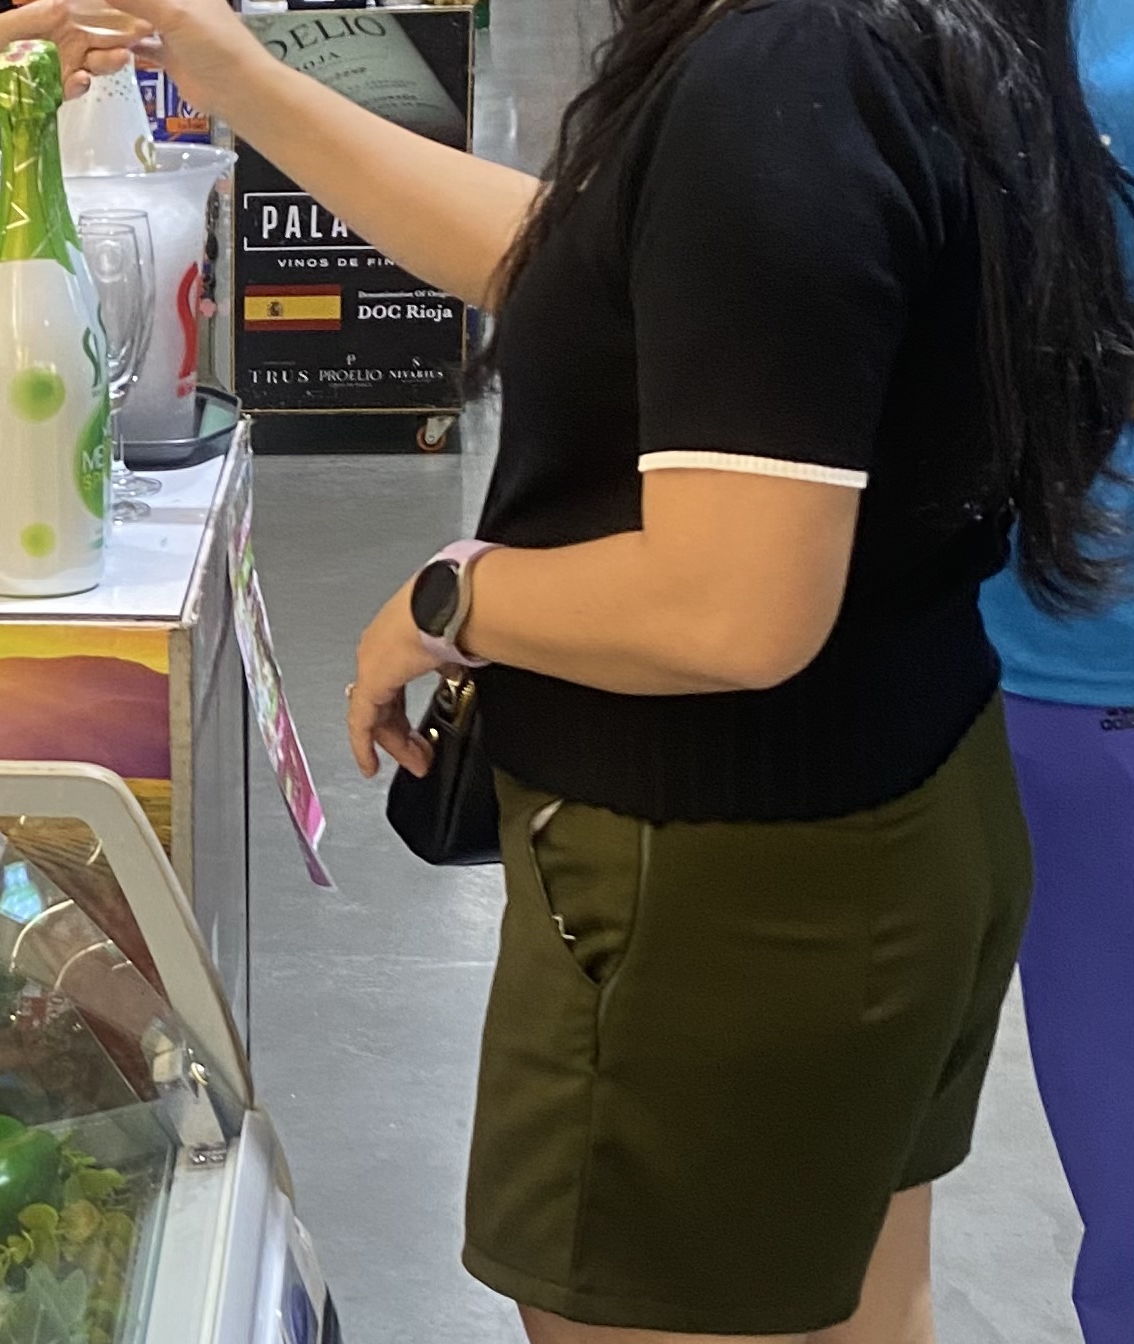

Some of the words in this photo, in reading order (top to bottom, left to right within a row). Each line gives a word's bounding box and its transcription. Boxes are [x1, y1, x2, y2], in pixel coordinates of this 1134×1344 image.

[261, 204, 349, 240] PALA
[277, 258, 329, 268] VINOS
[337, 258, 359, 268] DE
[367, 256, 395, 267] FIN
[357, 306, 401, 320] DOC
[406, 304, 453, 322] Rioja
[248, 369, 309, 384] TRUS
[319, 369, 383, 382] PROELIO
